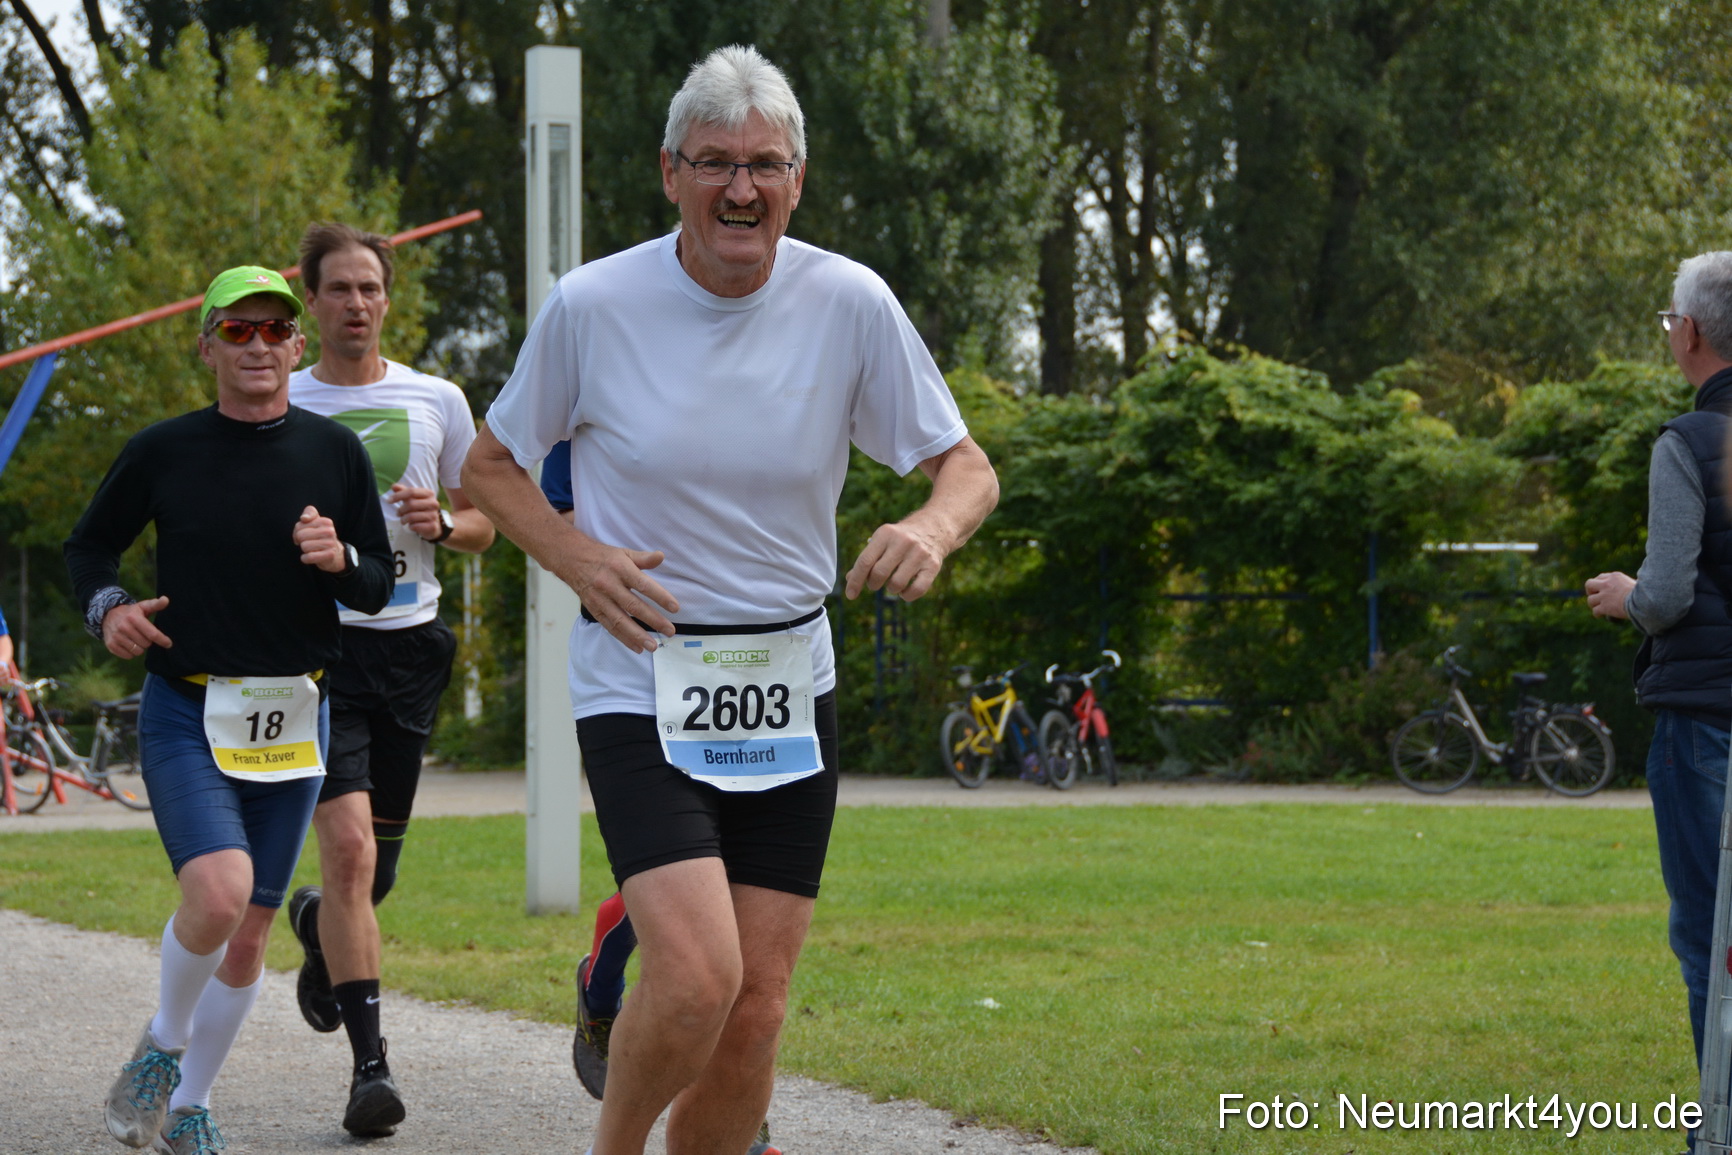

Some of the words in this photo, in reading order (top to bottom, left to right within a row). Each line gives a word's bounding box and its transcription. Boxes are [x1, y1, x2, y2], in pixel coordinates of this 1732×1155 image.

[720, 650, 770, 663] BOCK
[254, 687, 294, 697] BOCK
[682, 683, 790, 732] 2603
[246, 710, 285, 742] 18
[667, 725, 673, 734] D
[232, 753, 262, 765] Franz
[264, 750, 296, 764] Xaver
[704, 746, 775, 765] Bernhard
